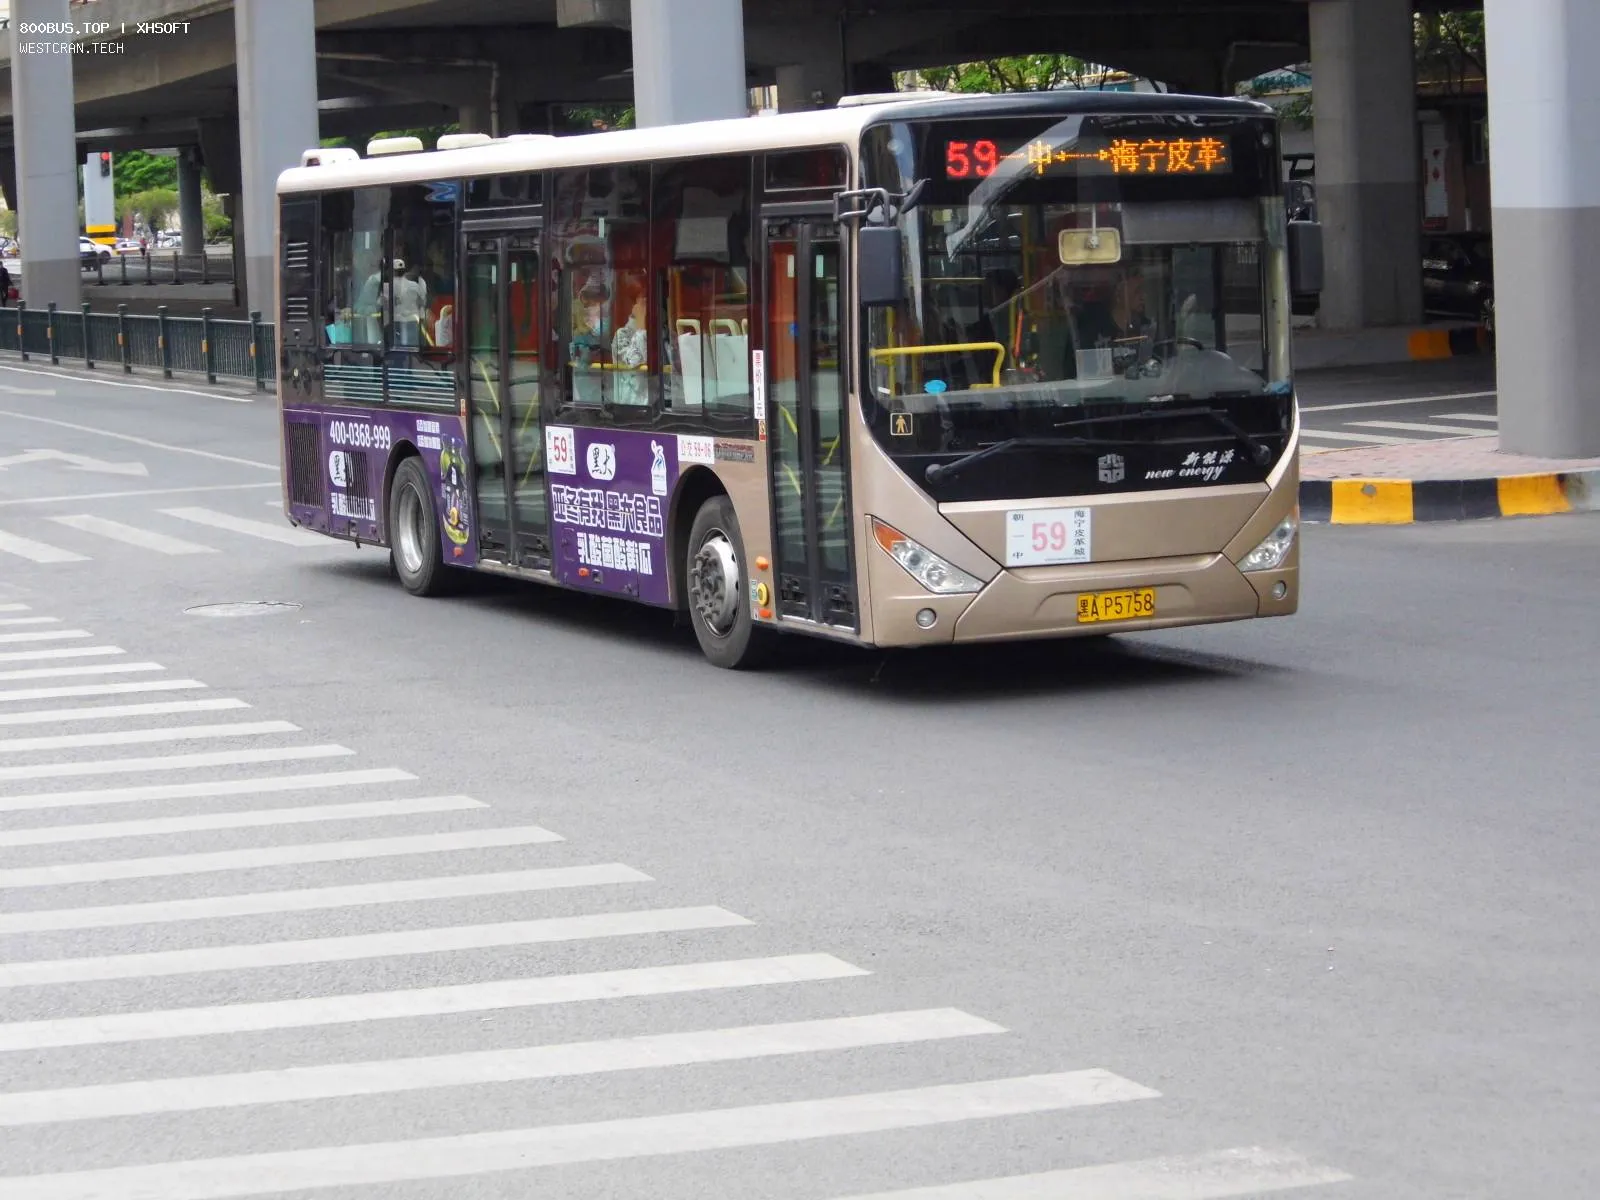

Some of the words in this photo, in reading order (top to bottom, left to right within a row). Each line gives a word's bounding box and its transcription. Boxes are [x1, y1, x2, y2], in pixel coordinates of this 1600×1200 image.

[946, 140, 997, 177] 59
[1110, 138, 1226, 172] 海宁皮革
[330, 420, 391, 450] 400-0368-999
[552, 436, 568, 463] 59
[1181, 449, 1235, 467] 新能源
[1145, 469, 1175, 480] new
[1178, 466, 1225, 482] energy
[1031, 521, 1067, 552] 59
